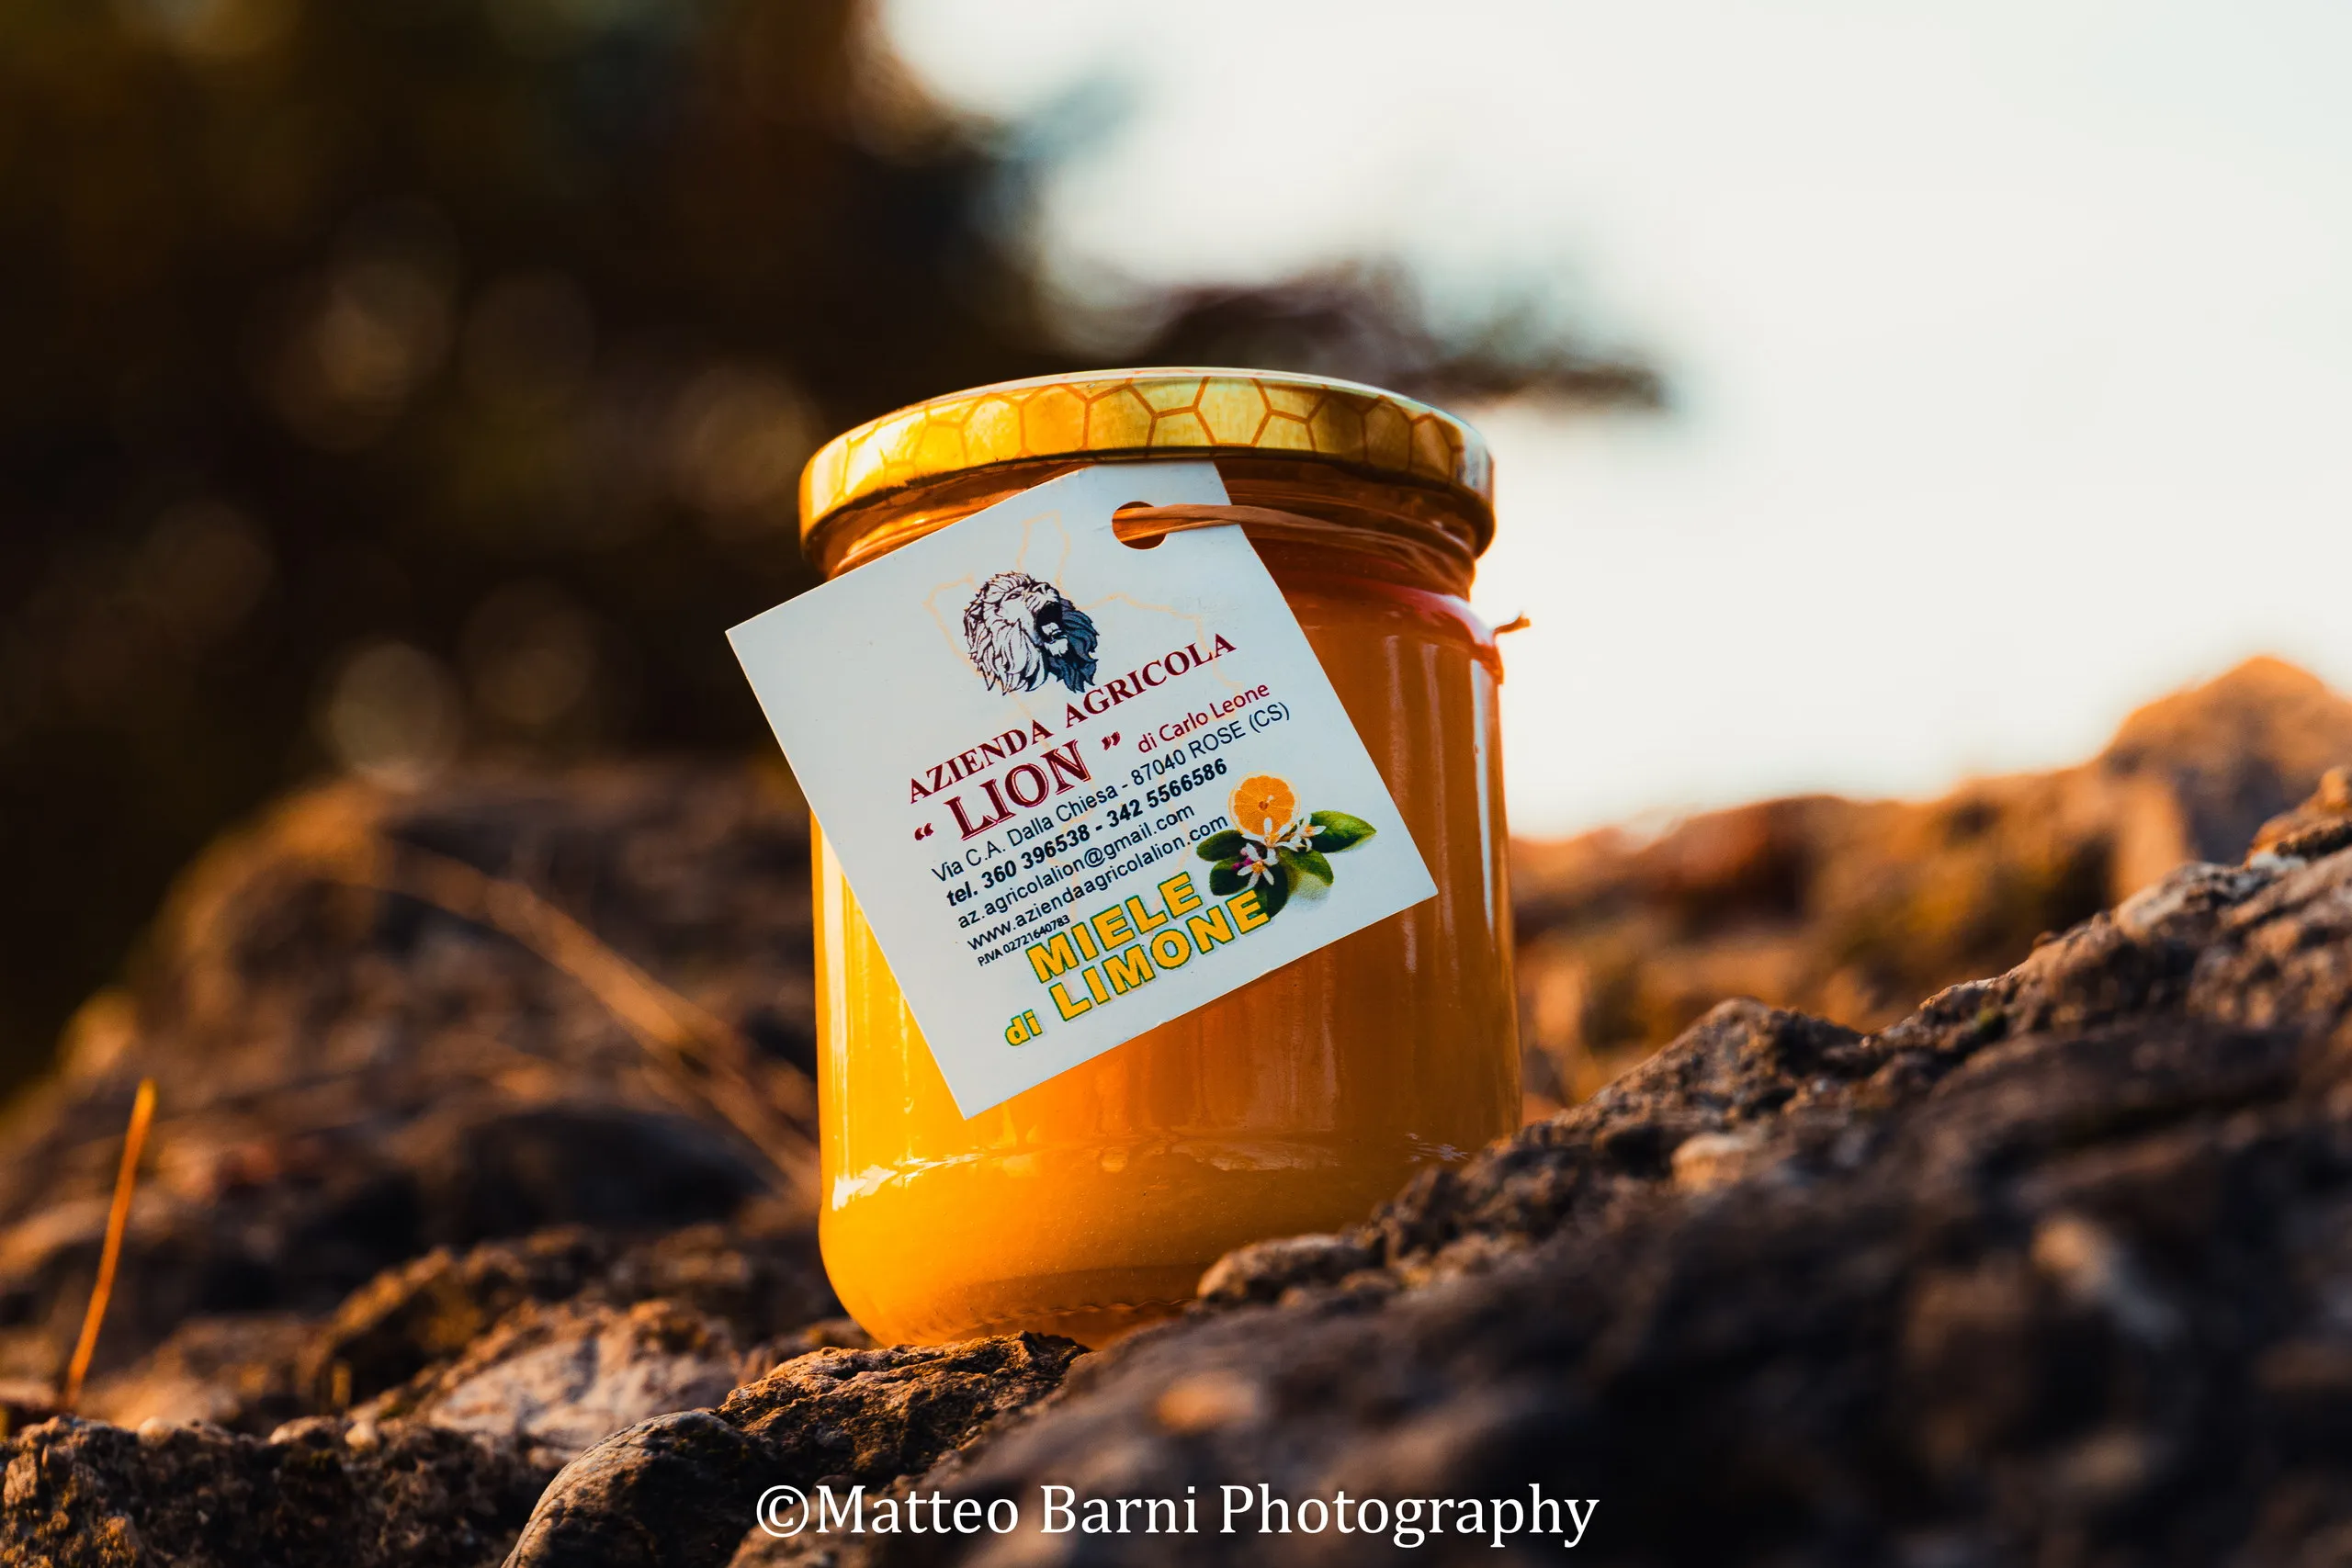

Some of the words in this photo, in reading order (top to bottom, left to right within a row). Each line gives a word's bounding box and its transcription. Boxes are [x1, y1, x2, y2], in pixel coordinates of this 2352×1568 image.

[909, 719, 1055, 804] AZIENDA
[1065, 633, 1237, 728] AGRICOLA
[1138, 734, 1157, 754] di
[1159, 709, 1208, 746] Carlo
[1210, 682, 1270, 719] Leone
[932, 862, 964, 883] Via
[967, 842, 1006, 868] C.A.
[1007, 817, 1054, 847] Dalla
[1056, 784, 1118, 823] Chiesa
[1131, 749, 1185, 785] 87040
[1189, 724, 1247, 759] ROSE
[1250, 701, 1290, 733] (CS)
[944, 739, 1092, 841] LION
[945, 878, 978, 907] tel.
[983, 862, 1017, 890] 360
[1021, 824, 1090, 869] 396538
[1106, 799, 1141, 828] 342
[1147, 758, 1227, 808] 5566586
[958, 804, 1194, 929] az.agricolalion@gmail.com
[967, 816, 1228, 951] www.aziendaagricolalion.com
[1025, 872, 1204, 984] MIELE
[1002, 914, 1070, 954] 02721640783
[1005, 1010, 1043, 1046] di
[1048, 890, 1272, 1021] LIMONE
